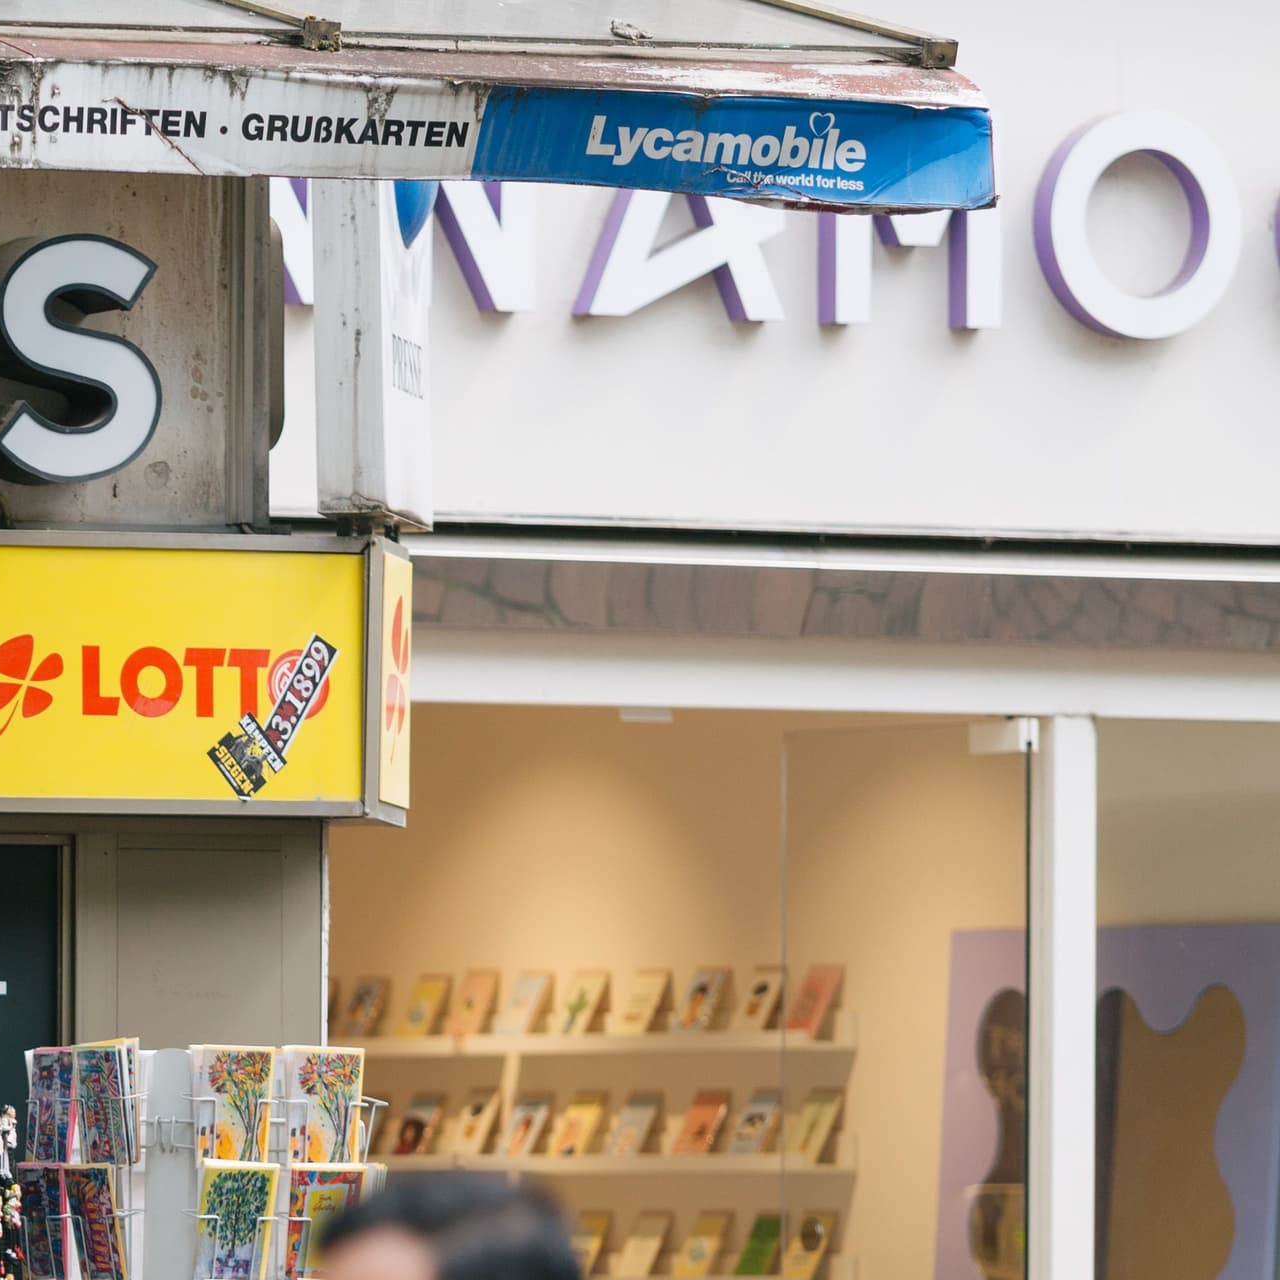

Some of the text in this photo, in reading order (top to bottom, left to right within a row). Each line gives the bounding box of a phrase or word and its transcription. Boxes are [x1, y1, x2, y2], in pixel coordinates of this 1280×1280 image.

[241, 112, 469, 148] GRUßKARTEN
[586, 111, 867, 173] Lycamobile
[816, 174, 836, 188] for
[836, 176, 864, 191] less
